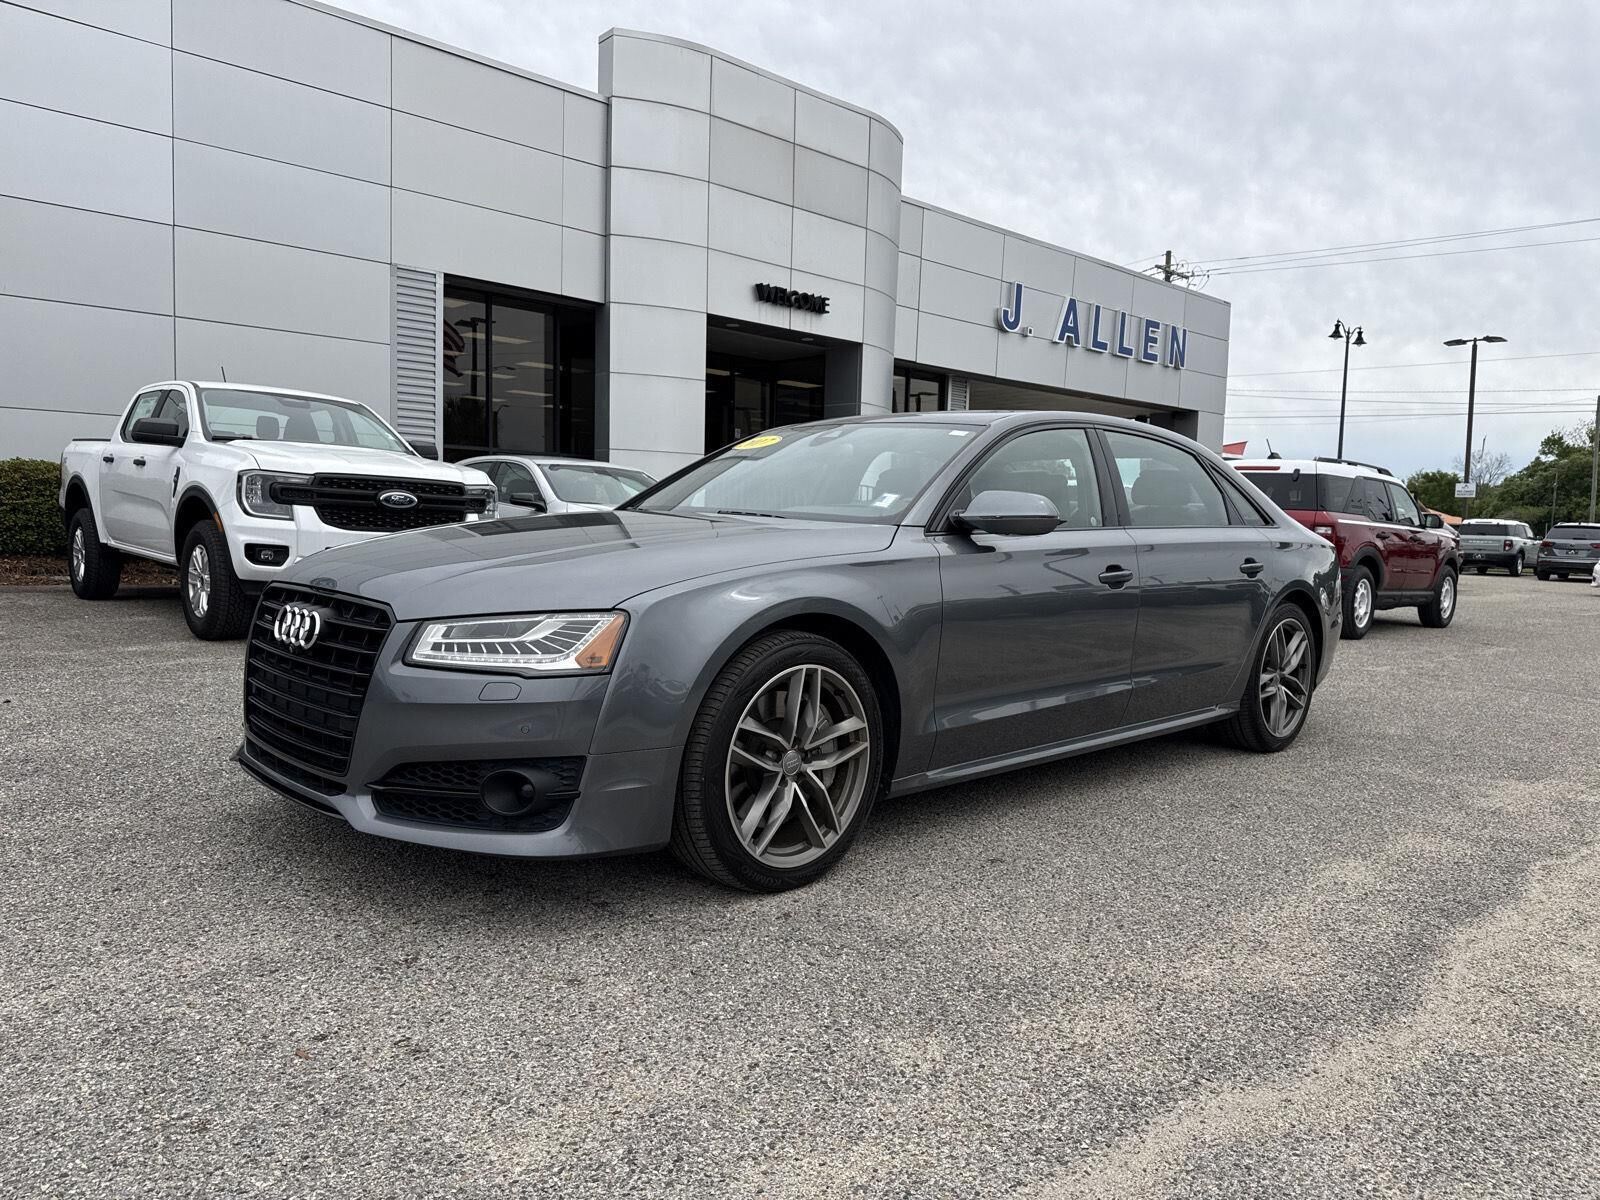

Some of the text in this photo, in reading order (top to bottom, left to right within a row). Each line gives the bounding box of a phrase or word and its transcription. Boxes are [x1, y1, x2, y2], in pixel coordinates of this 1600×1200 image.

[755, 283, 830, 314] WELCOME
[999, 281, 1188, 370] J. ALLEN
